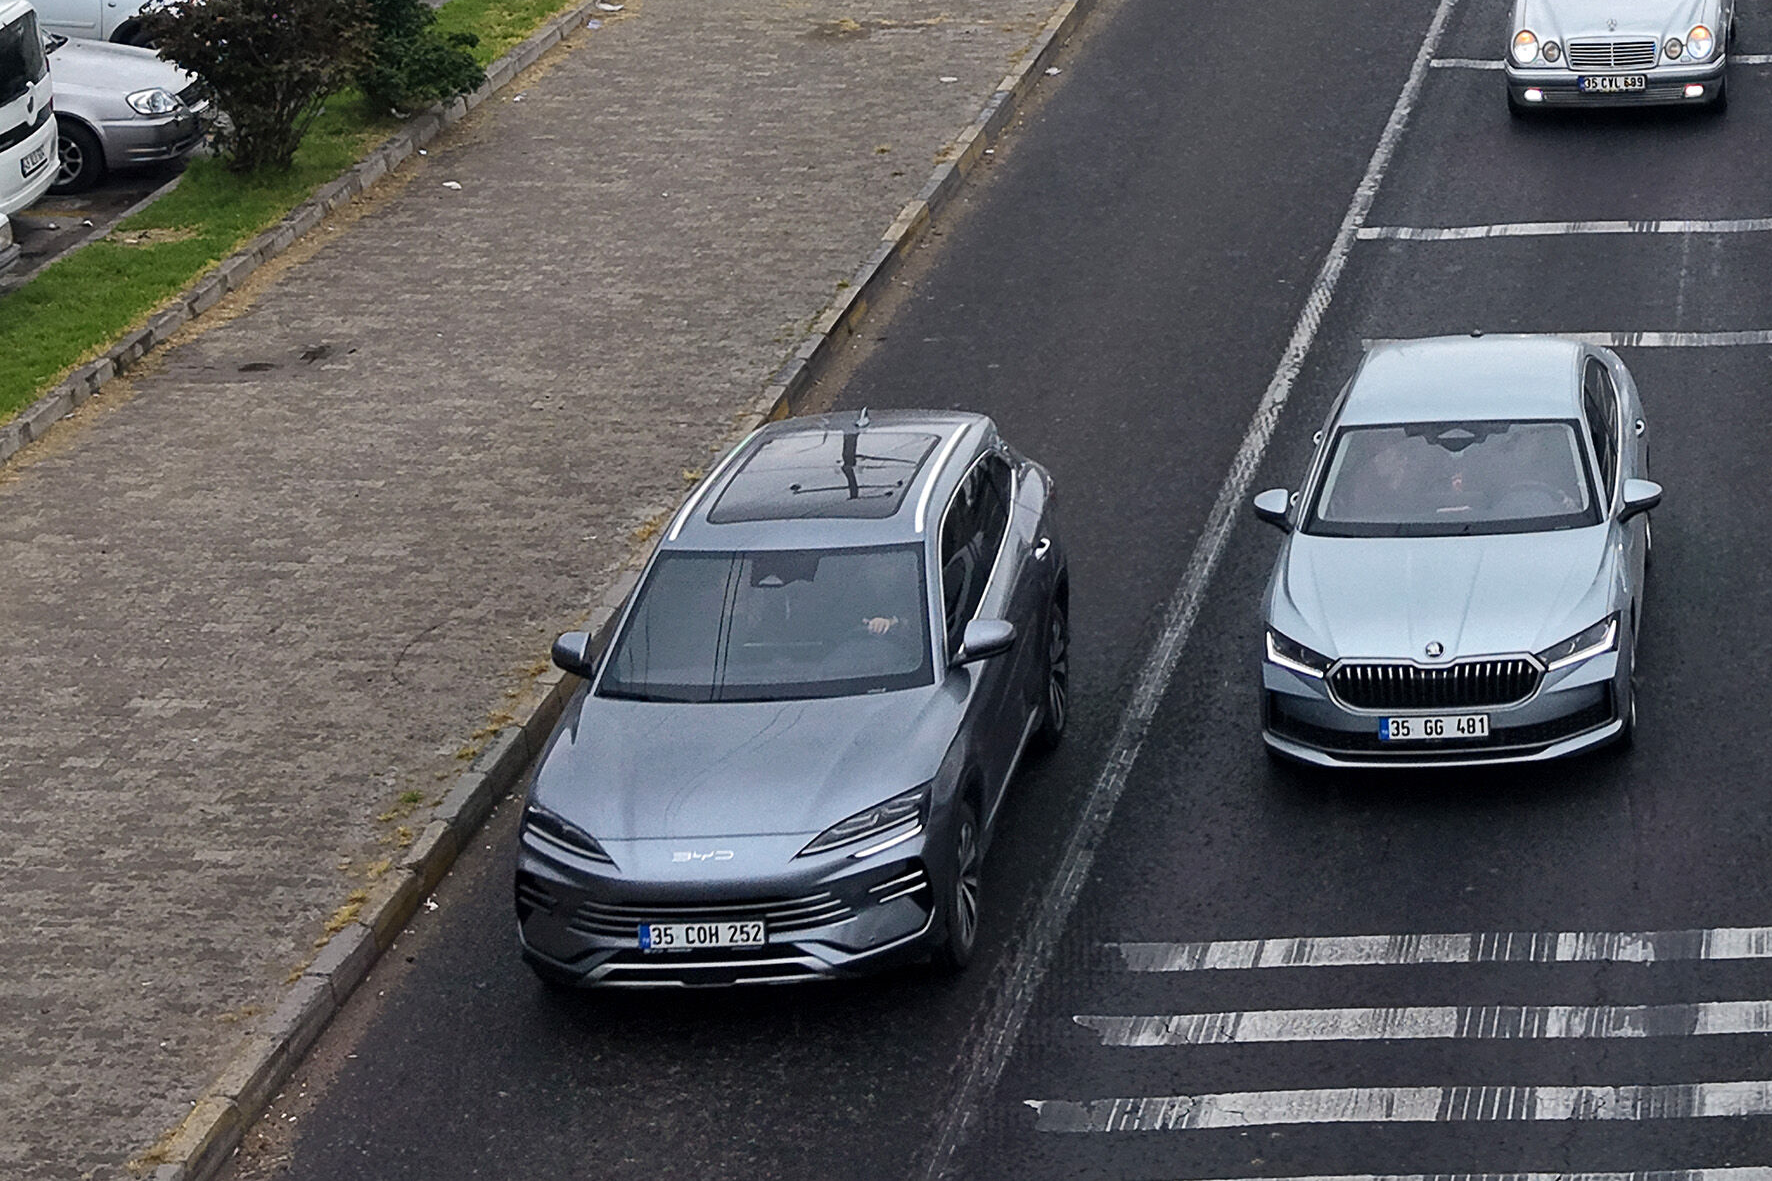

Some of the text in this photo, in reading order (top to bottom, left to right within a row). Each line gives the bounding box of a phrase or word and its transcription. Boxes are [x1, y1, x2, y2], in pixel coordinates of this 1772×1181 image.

[1585, 78, 1598, 89] 35
[1391, 717, 1485, 737] 35 GG 481
[672, 850, 735, 863] BYD
[652, 924, 762, 945] 35 COH 252
